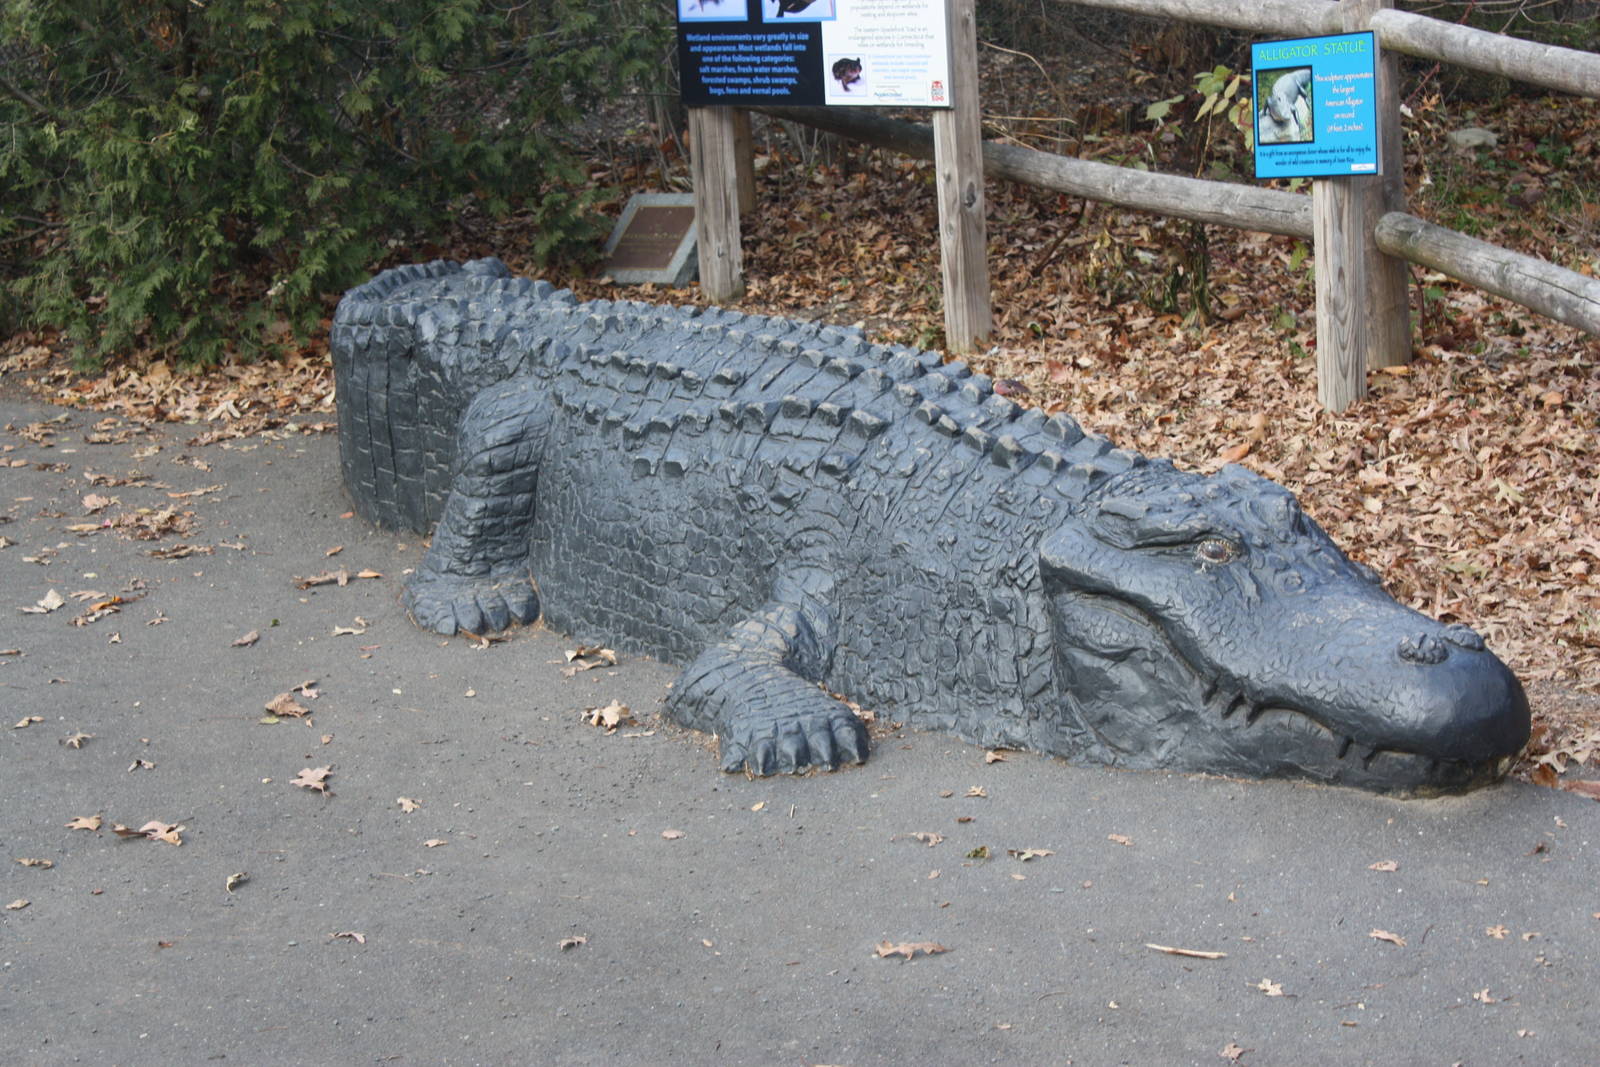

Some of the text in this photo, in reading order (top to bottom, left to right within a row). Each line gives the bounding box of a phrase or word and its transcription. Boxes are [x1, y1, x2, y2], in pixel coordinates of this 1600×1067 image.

[767, 33, 788, 42] greatly
[1260, 40, 1366, 60] ALLIGATOR STATUE
[732, 54, 760, 64] following
[761, 56, 794, 64] categories:
